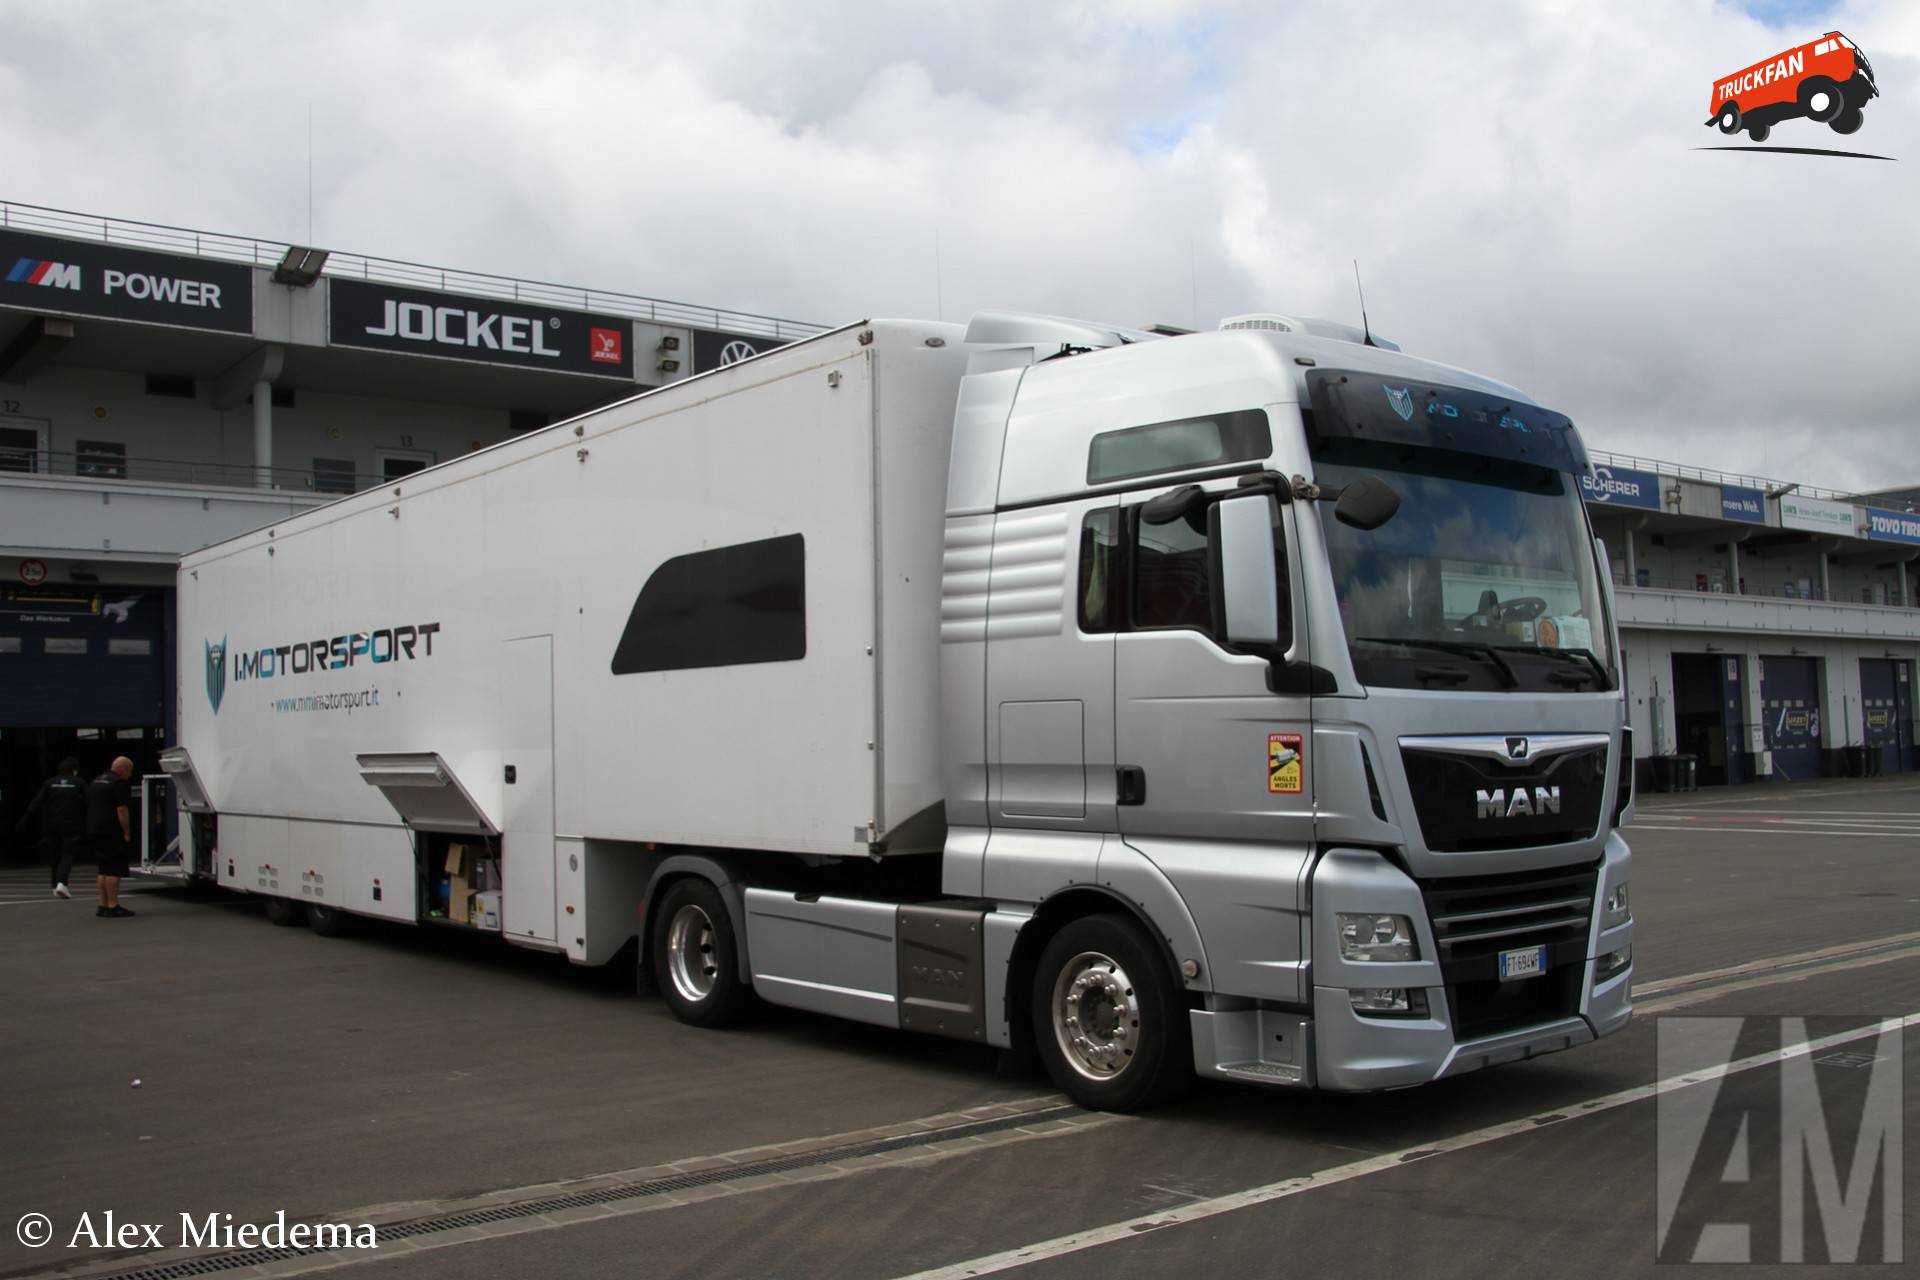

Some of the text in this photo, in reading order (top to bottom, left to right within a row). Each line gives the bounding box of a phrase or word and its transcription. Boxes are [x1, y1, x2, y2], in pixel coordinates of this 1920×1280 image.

[104, 269, 222, 309] POWER
[365, 299, 561, 357] JOCKEL
[3, 400, 21, 413] 12
[1582, 475, 1640, 497] SCHERER
[1871, 516, 1900, 535] TOYO
[1476, 786, 1560, 819] MAN
